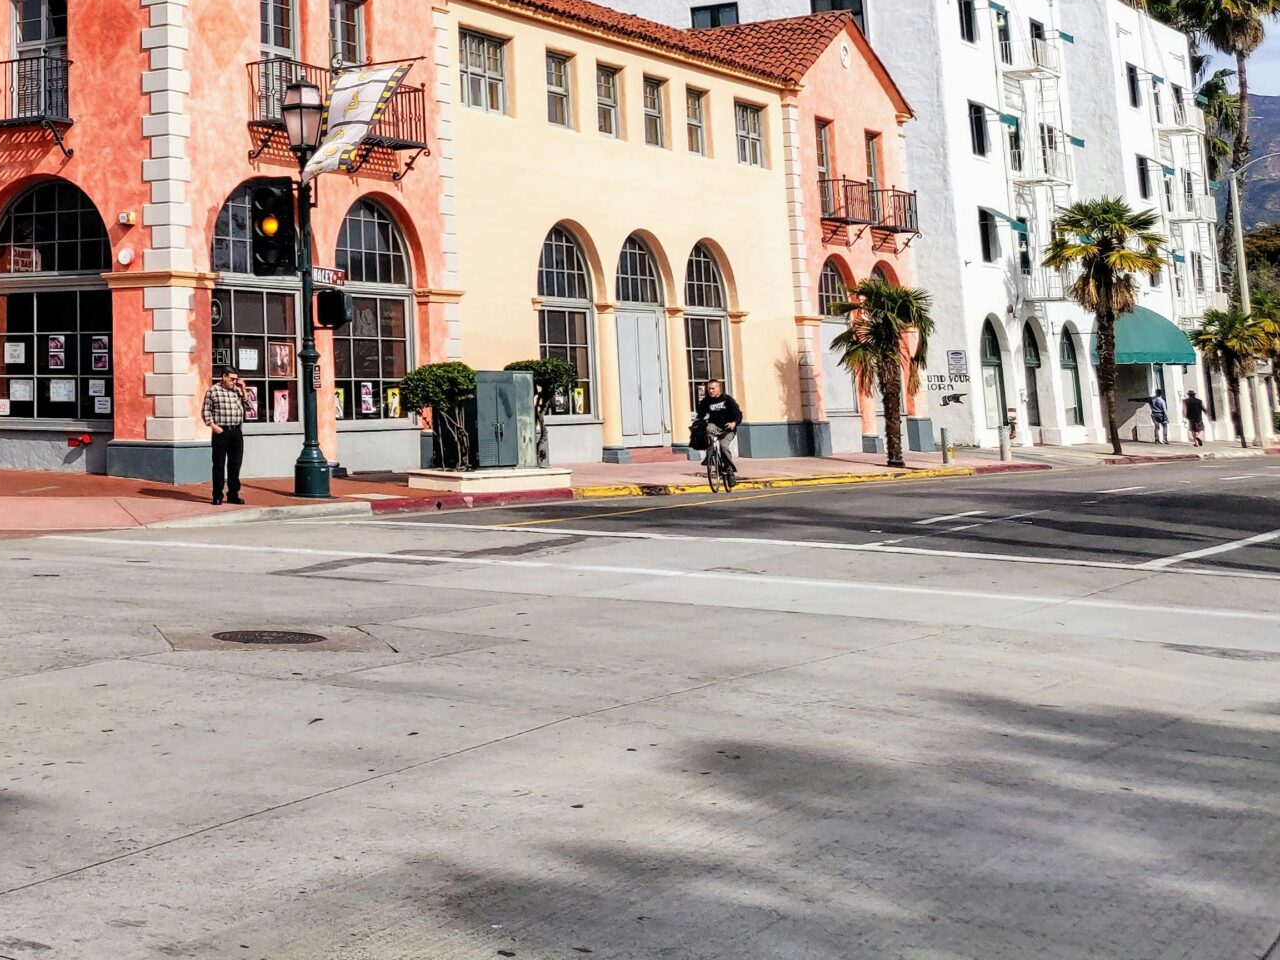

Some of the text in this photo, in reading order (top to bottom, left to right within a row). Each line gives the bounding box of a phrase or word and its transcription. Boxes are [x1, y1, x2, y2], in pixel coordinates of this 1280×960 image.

[313, 268, 334, 283] HALEY
[212, 350, 230, 365] PEN
[927, 374, 971, 383] UND YOUR
